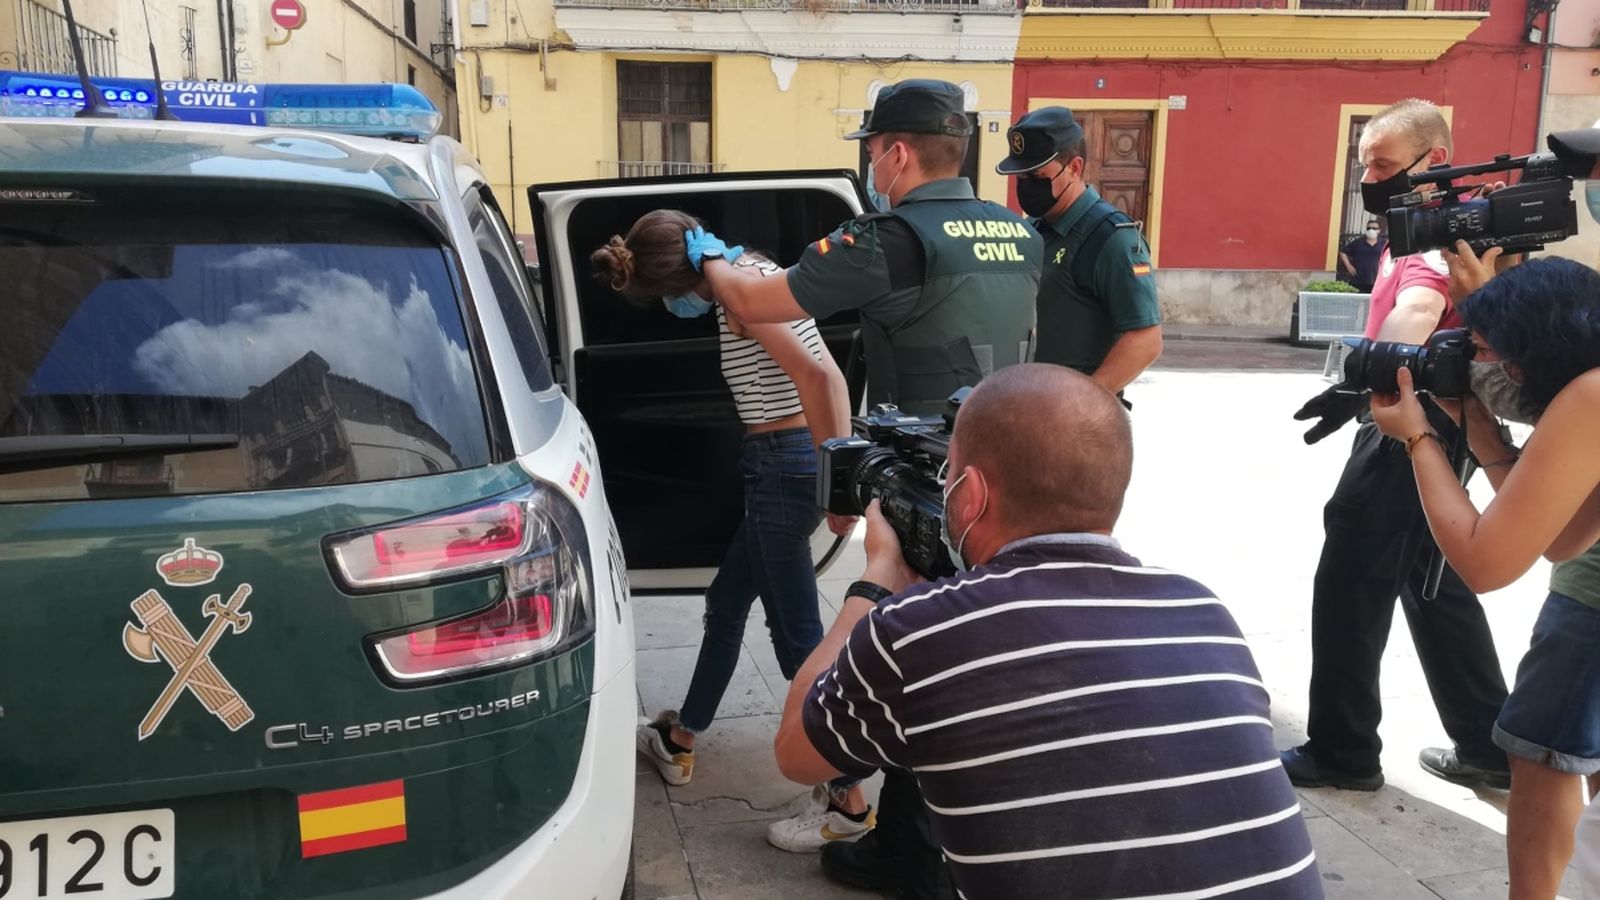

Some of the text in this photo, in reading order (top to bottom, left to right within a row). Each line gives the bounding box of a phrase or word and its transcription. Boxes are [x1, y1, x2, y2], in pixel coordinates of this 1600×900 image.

[161, 82, 258, 94] GUARDIA
[179, 92, 237, 107] CIVIL
[943, 220, 1031, 238] GUARDIA
[973, 242, 1025, 261] CIVIL
[265, 689, 540, 749] C4 SPACETOURER
